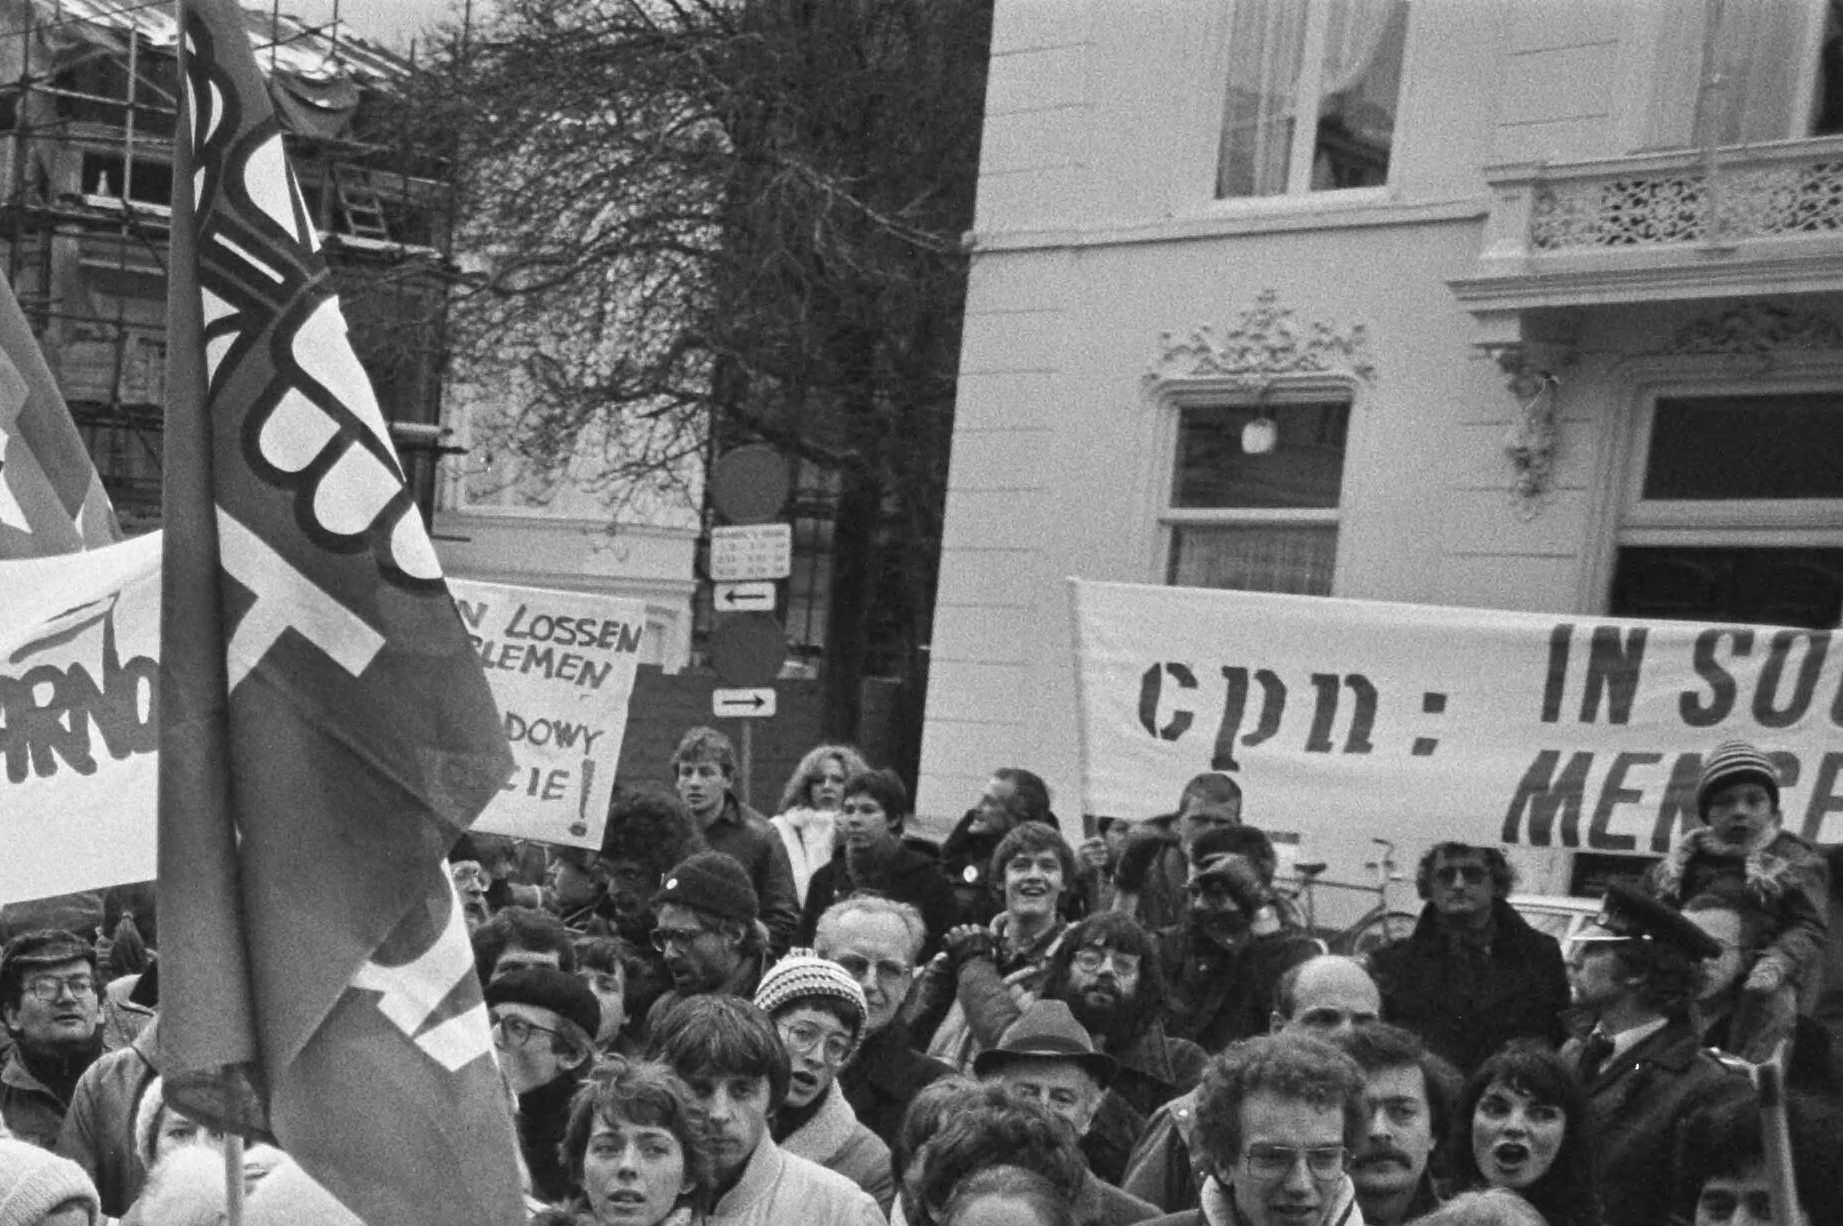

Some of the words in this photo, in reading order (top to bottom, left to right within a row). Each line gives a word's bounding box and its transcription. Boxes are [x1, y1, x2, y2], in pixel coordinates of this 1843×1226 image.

[505, 603, 643, 654] LOSSEN
[1541, 624, 1648, 724] IN
[1679, 629, 1843, 728] SO
